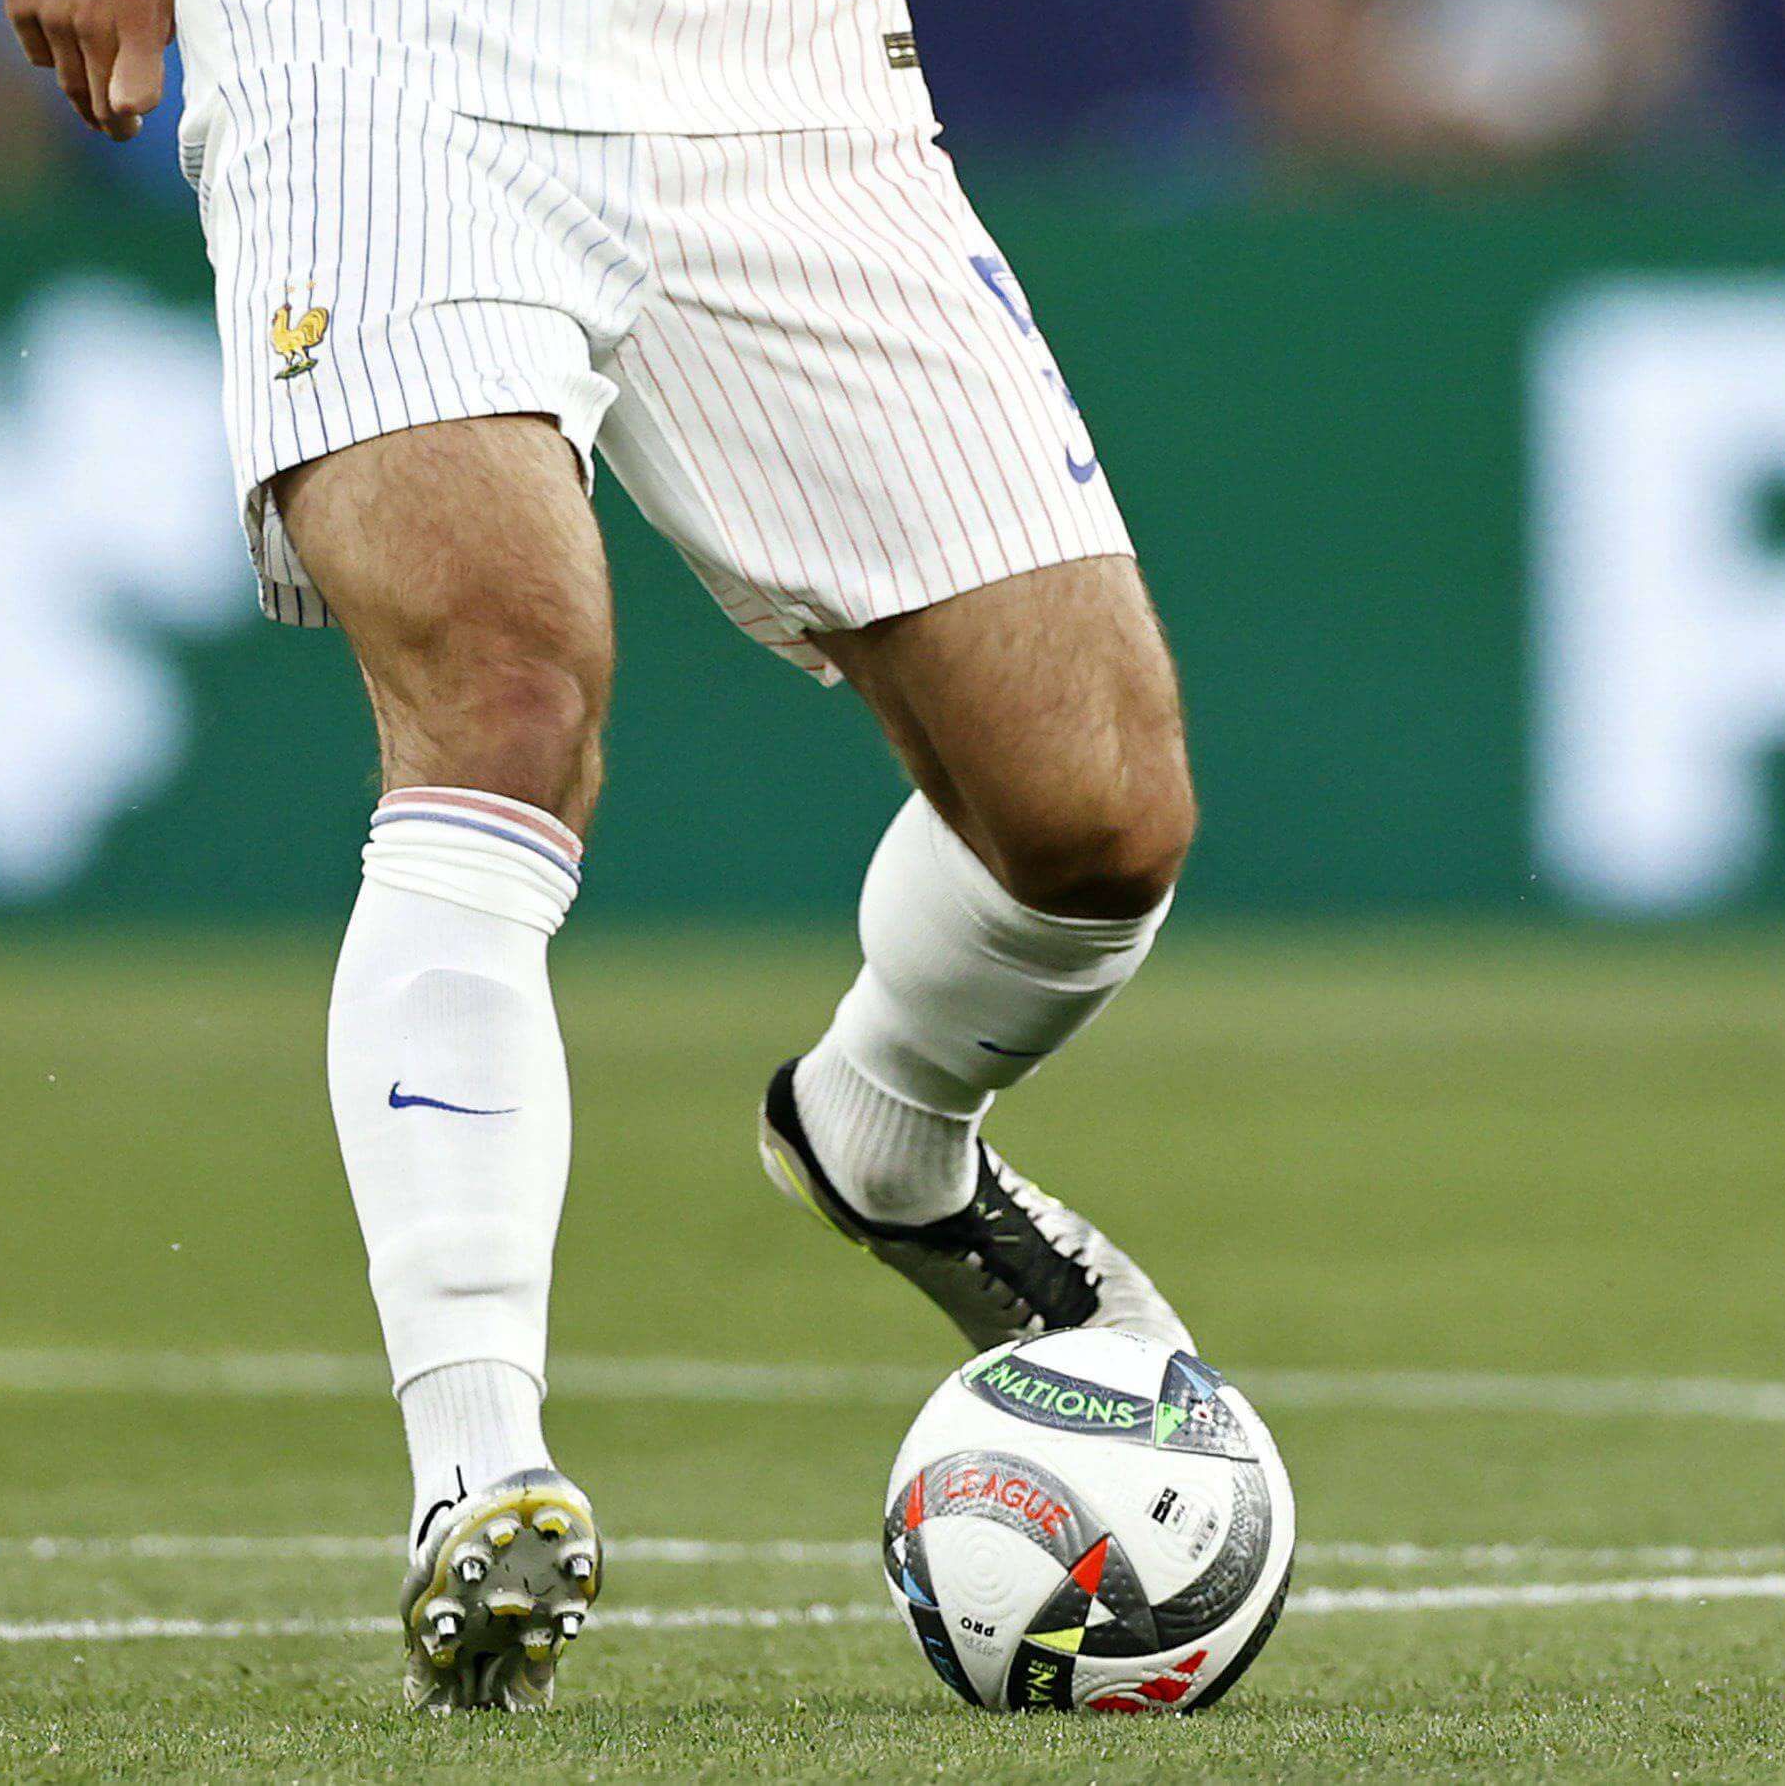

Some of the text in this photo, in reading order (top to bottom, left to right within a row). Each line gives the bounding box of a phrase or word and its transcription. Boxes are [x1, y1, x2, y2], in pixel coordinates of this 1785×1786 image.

[988, 1364, 1136, 1429] NATIONS
[942, 1466, 1072, 1537] LEAGUE
[960, 1616, 996, 1638] PRO
